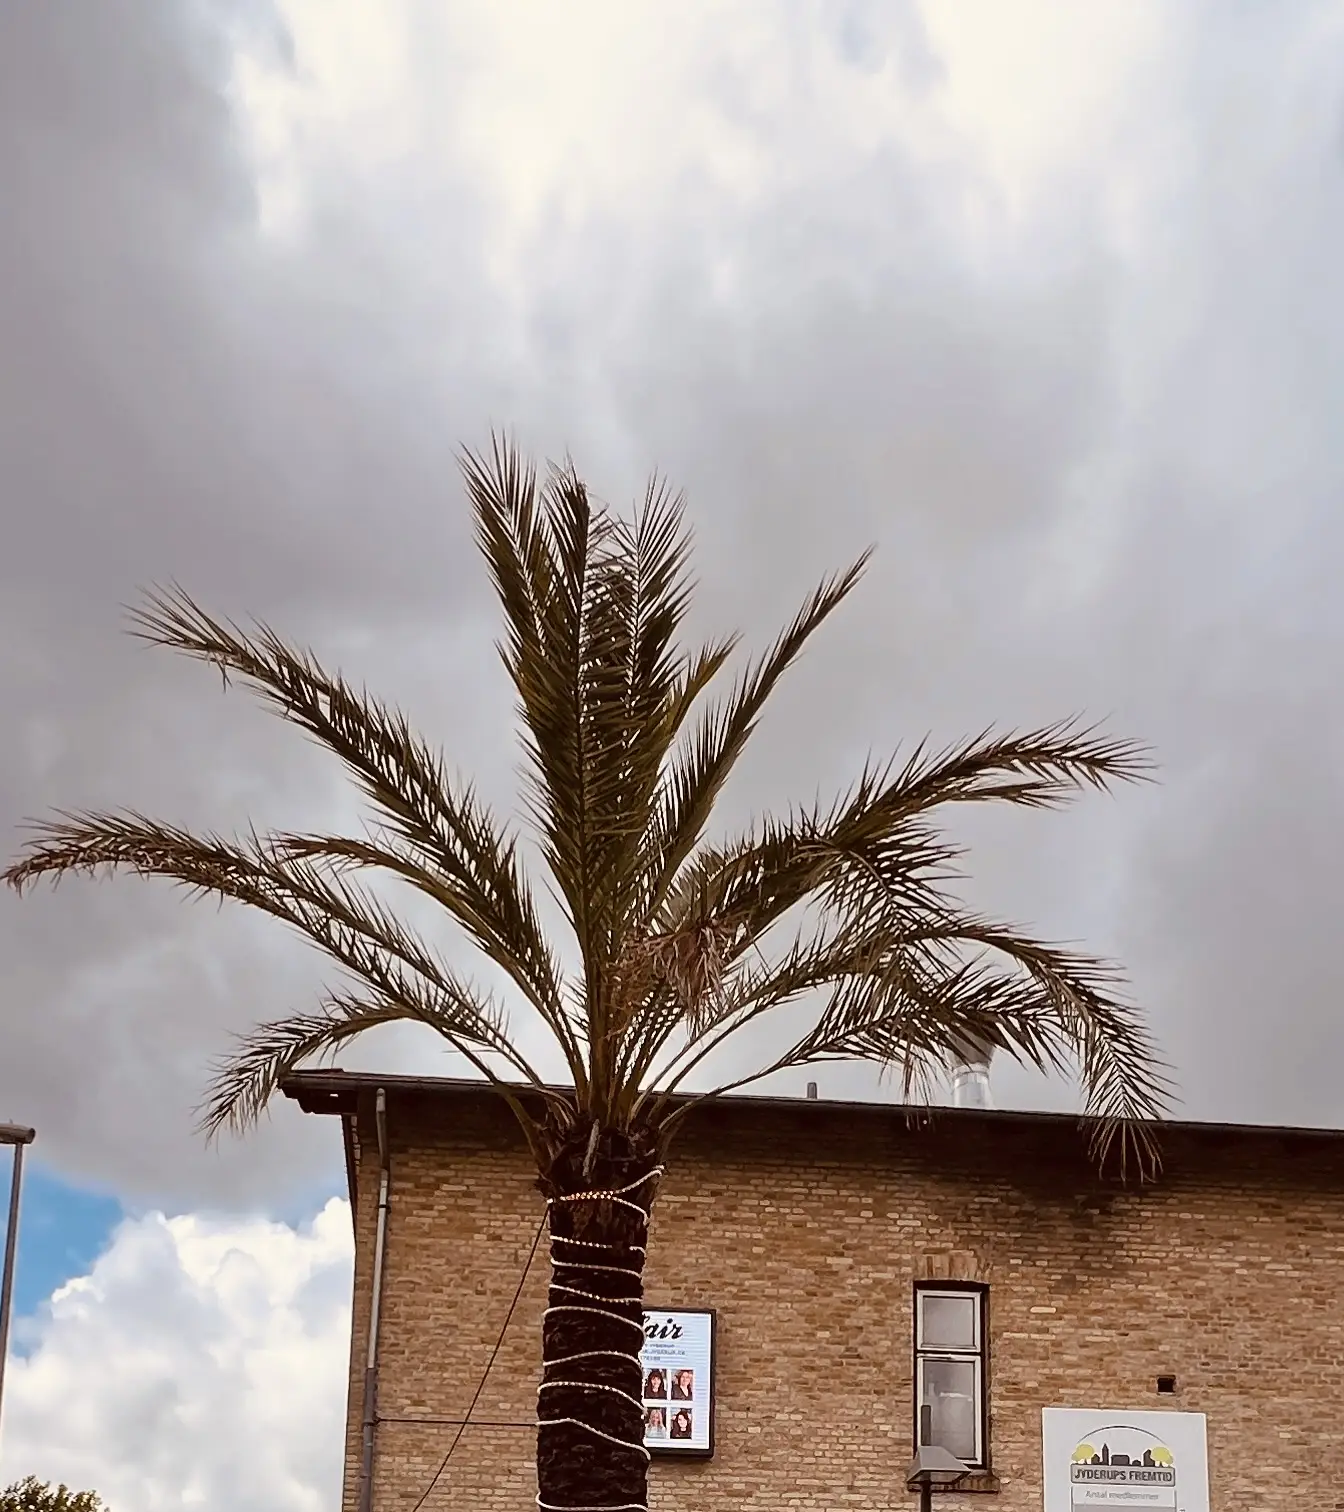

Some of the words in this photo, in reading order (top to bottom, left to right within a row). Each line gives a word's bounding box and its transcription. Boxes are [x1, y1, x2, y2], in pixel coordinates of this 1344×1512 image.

[644, 1315, 683, 1339] air
[1074, 1469, 1126, 1481] JYDERUPS
[1129, 1470, 1172, 1482] FREMTID
